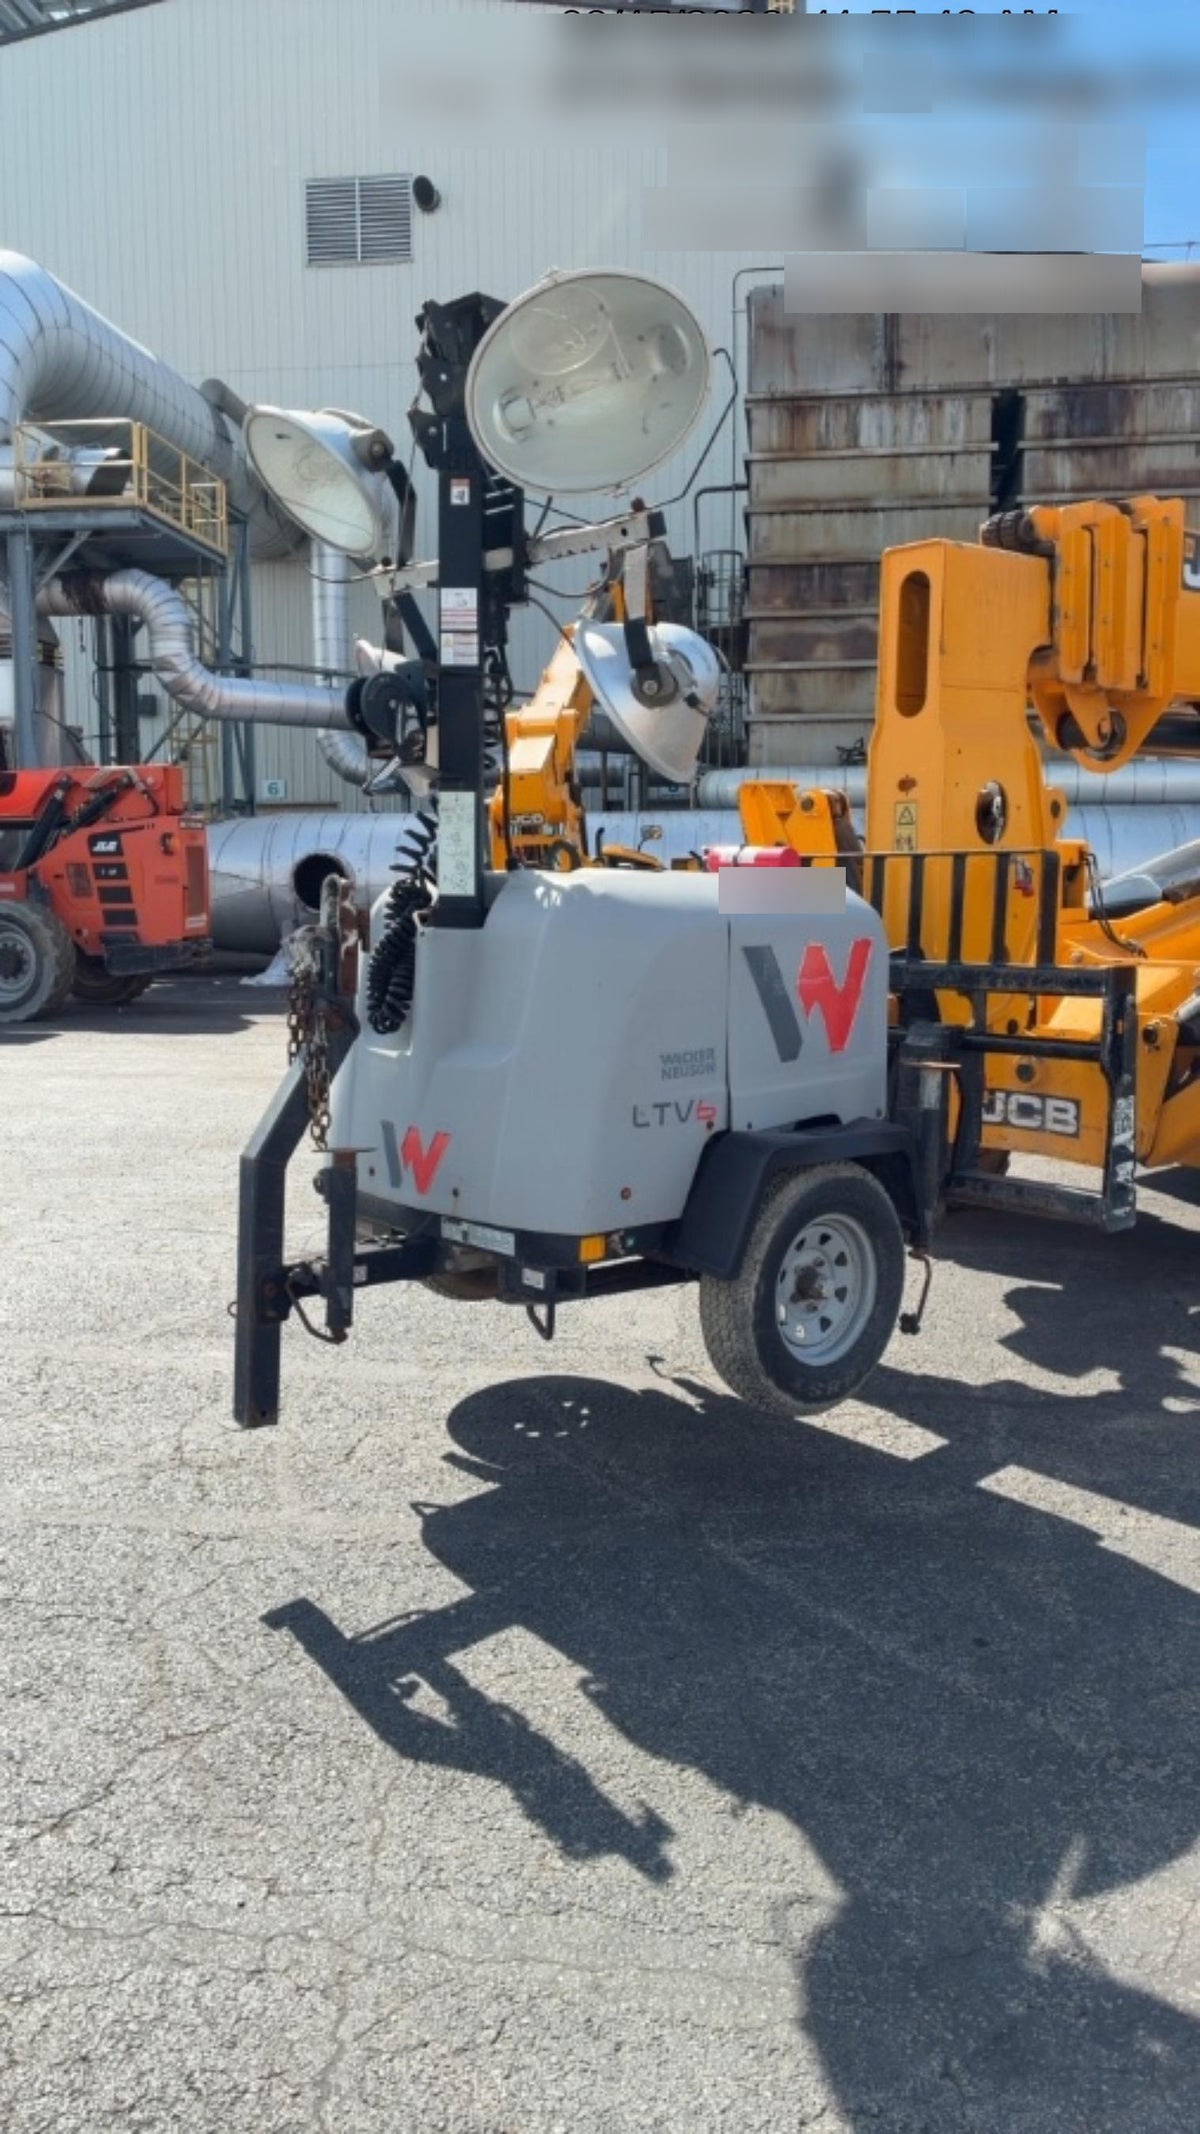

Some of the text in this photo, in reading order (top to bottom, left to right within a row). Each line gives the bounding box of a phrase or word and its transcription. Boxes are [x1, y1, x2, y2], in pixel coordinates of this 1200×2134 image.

[267, 782, 279, 796] 6
[659, 1047, 715, 1065] WACKER
[661, 1063, 716, 1081] NEUSON
[982, 1091, 1079, 1135] JCB
